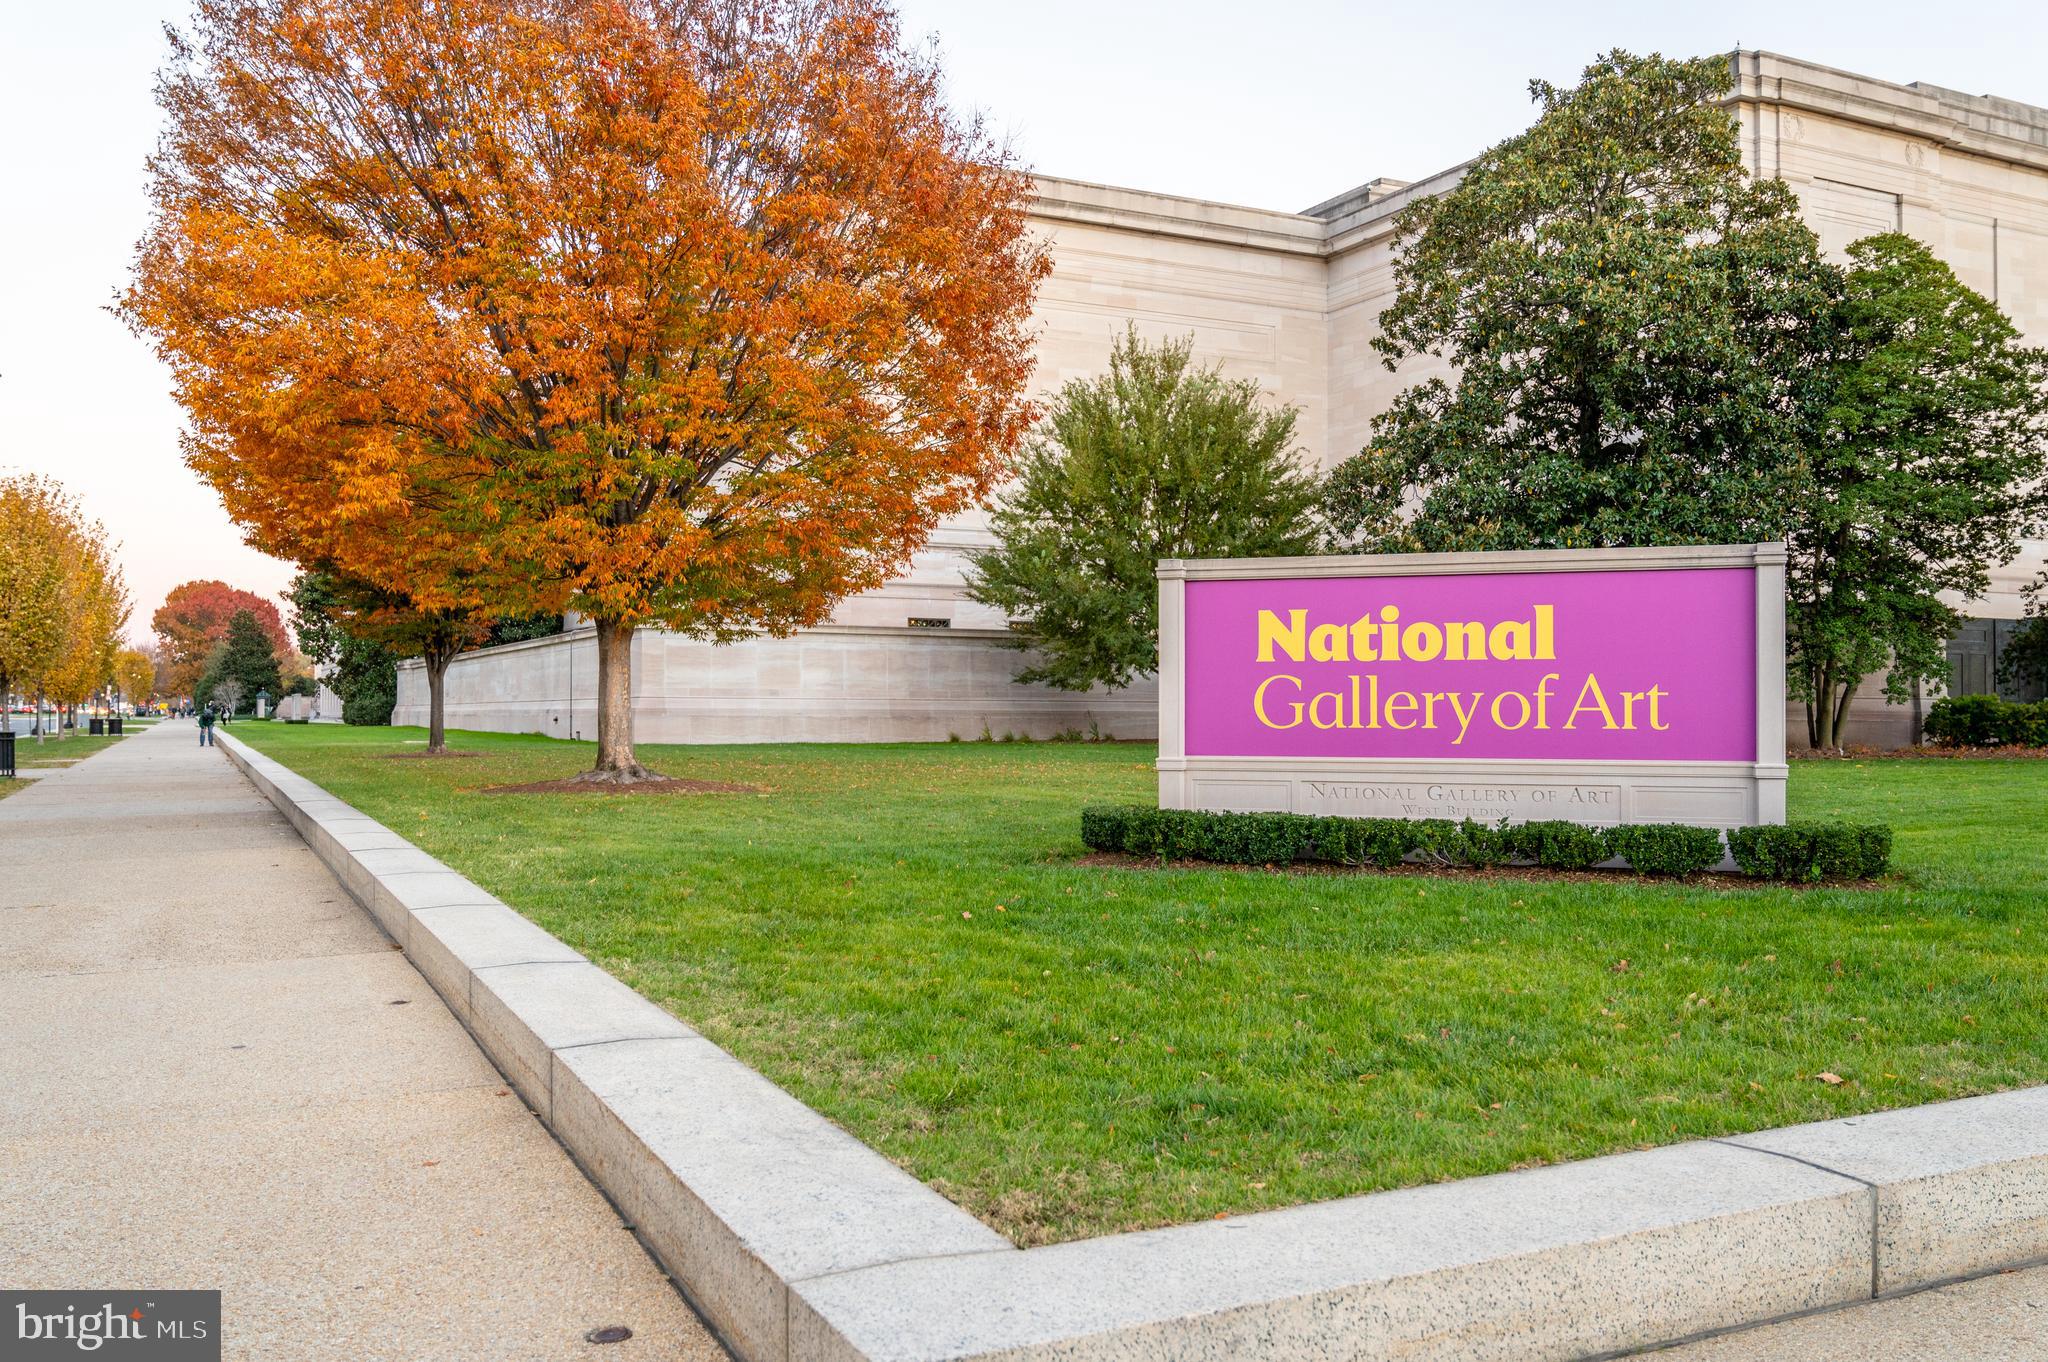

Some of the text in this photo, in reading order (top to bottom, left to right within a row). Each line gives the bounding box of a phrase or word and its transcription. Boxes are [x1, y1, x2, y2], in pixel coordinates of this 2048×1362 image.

[1256, 605, 1556, 663] National
[1253, 673, 1670, 745] Gallery of Art
